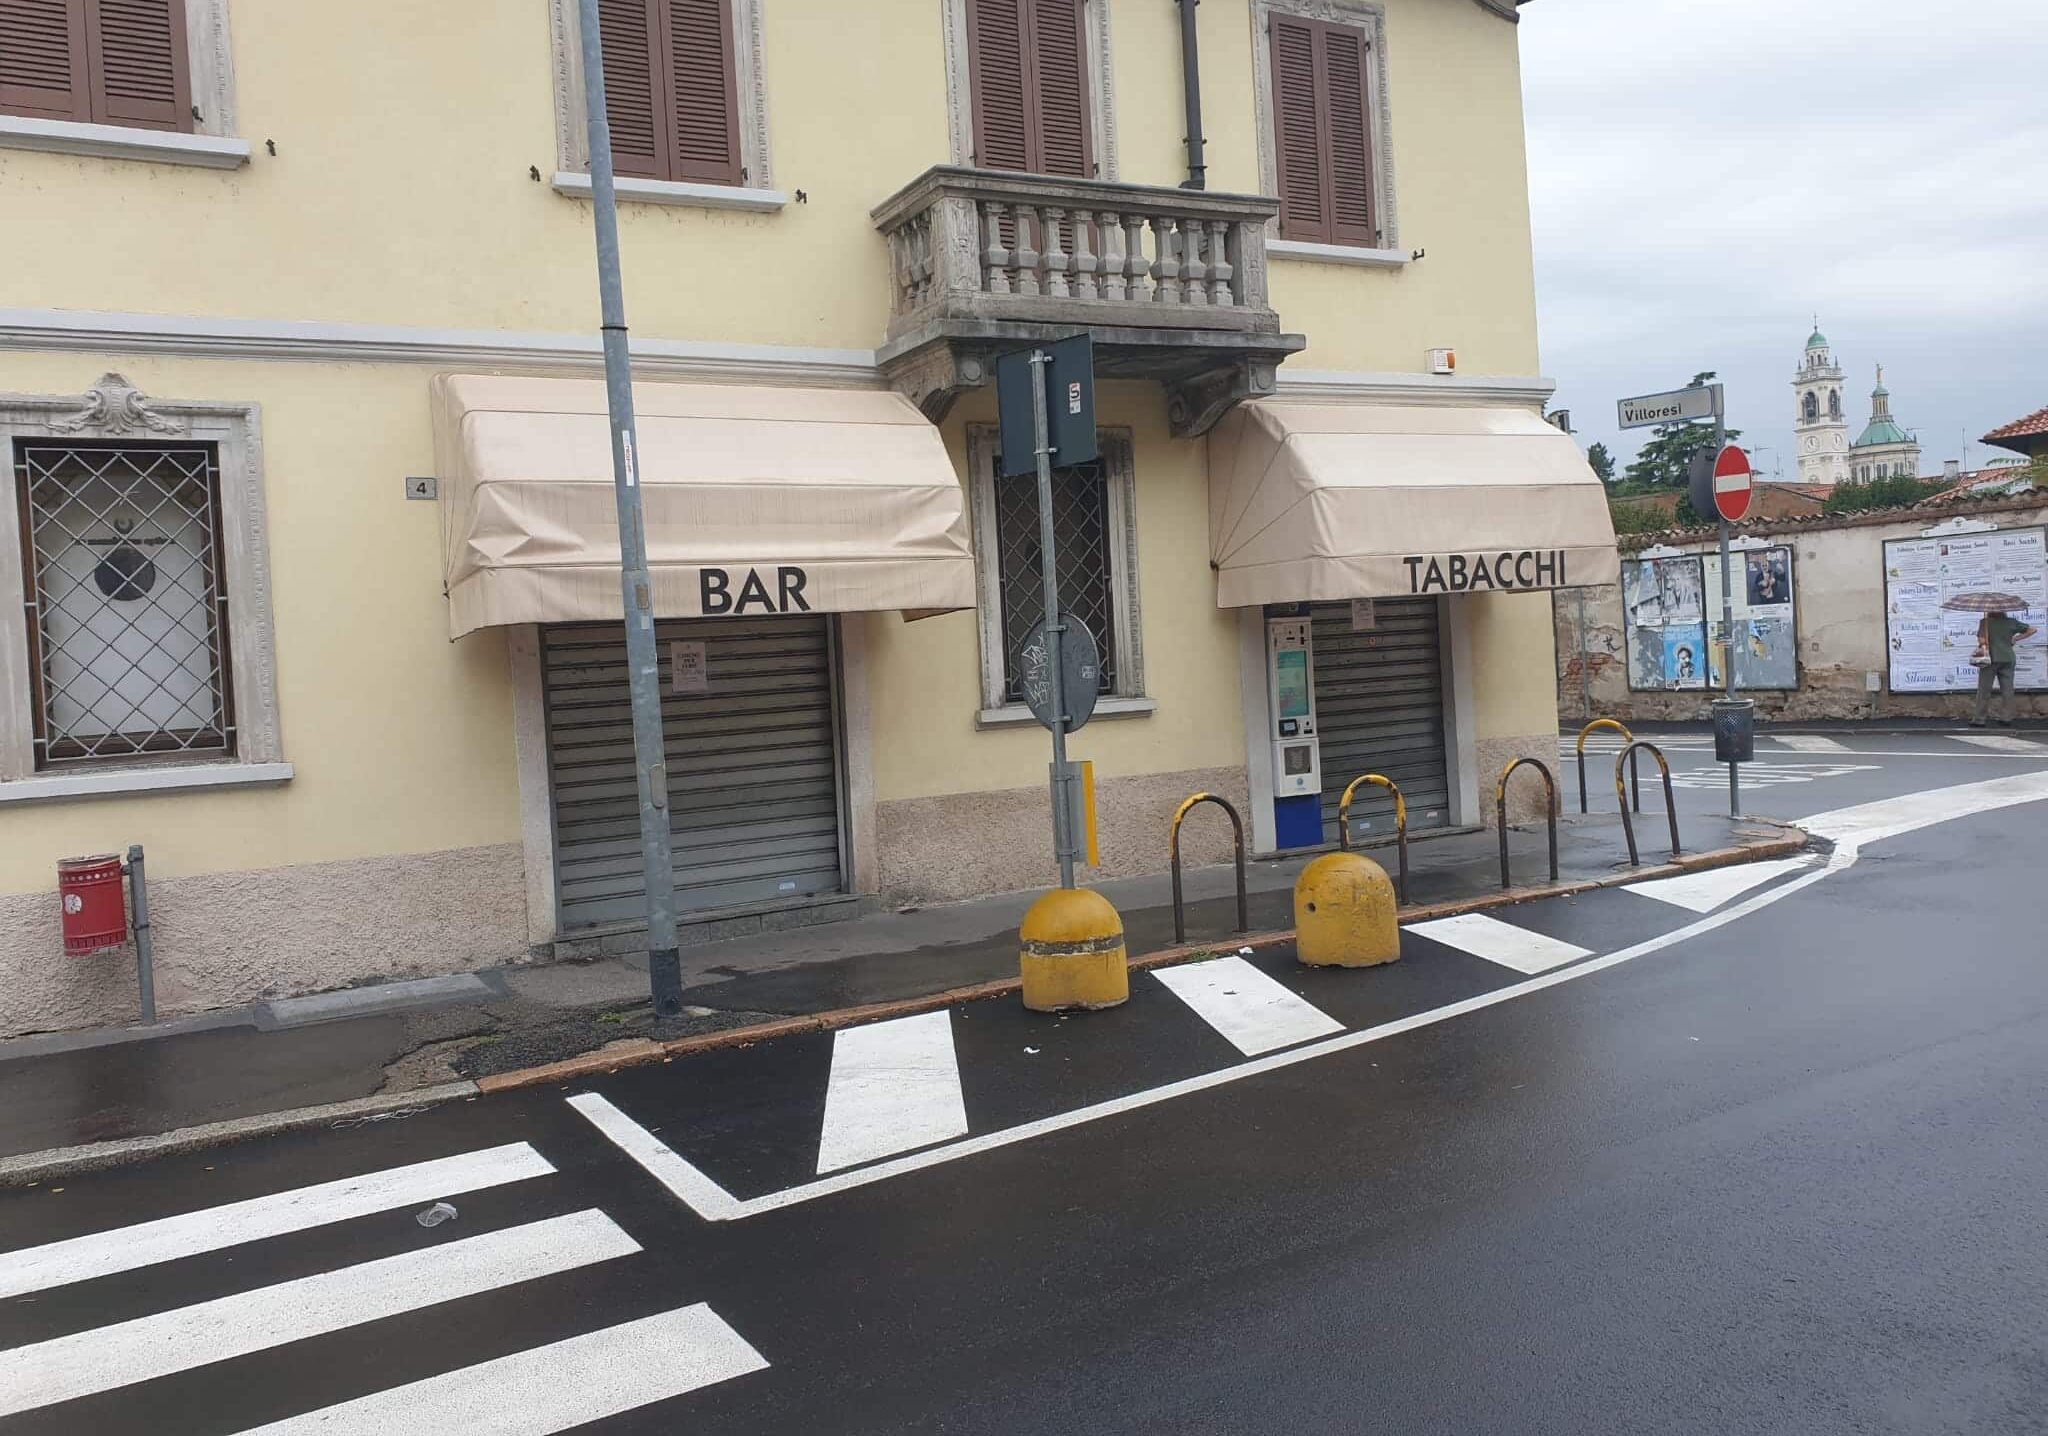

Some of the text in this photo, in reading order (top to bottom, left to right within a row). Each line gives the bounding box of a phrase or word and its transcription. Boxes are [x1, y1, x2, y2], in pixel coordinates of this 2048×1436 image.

[1625, 403, 1682, 422] Villoresi
[416, 482, 427, 494] 4
[1403, 550, 1567, 593] TABACCHI
[700, 566, 811, 615] BAR
